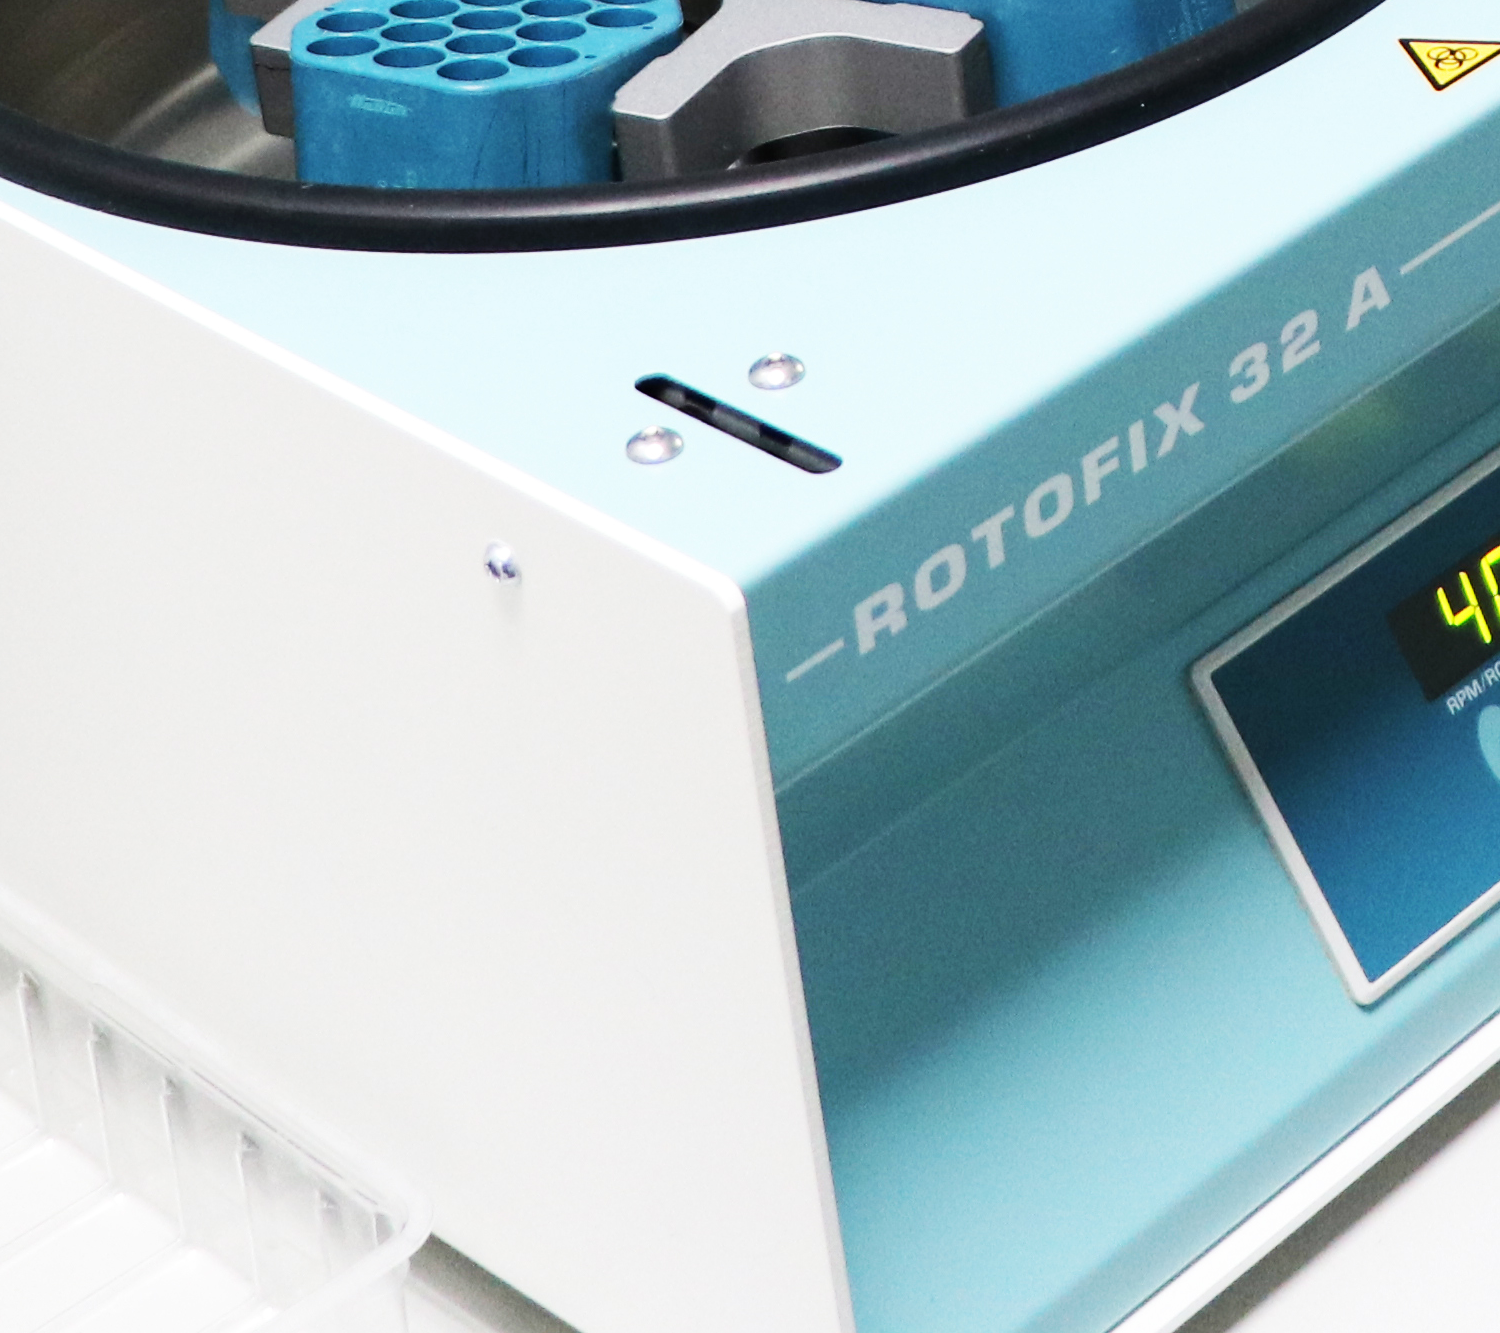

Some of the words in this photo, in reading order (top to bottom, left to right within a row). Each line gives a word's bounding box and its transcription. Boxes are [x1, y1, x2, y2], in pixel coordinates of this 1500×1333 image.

[853, 381, 1206, 657] ROTOFIX
[1229, 309, 1321, 404] 32
[1344, 265, 1392, 329] A
